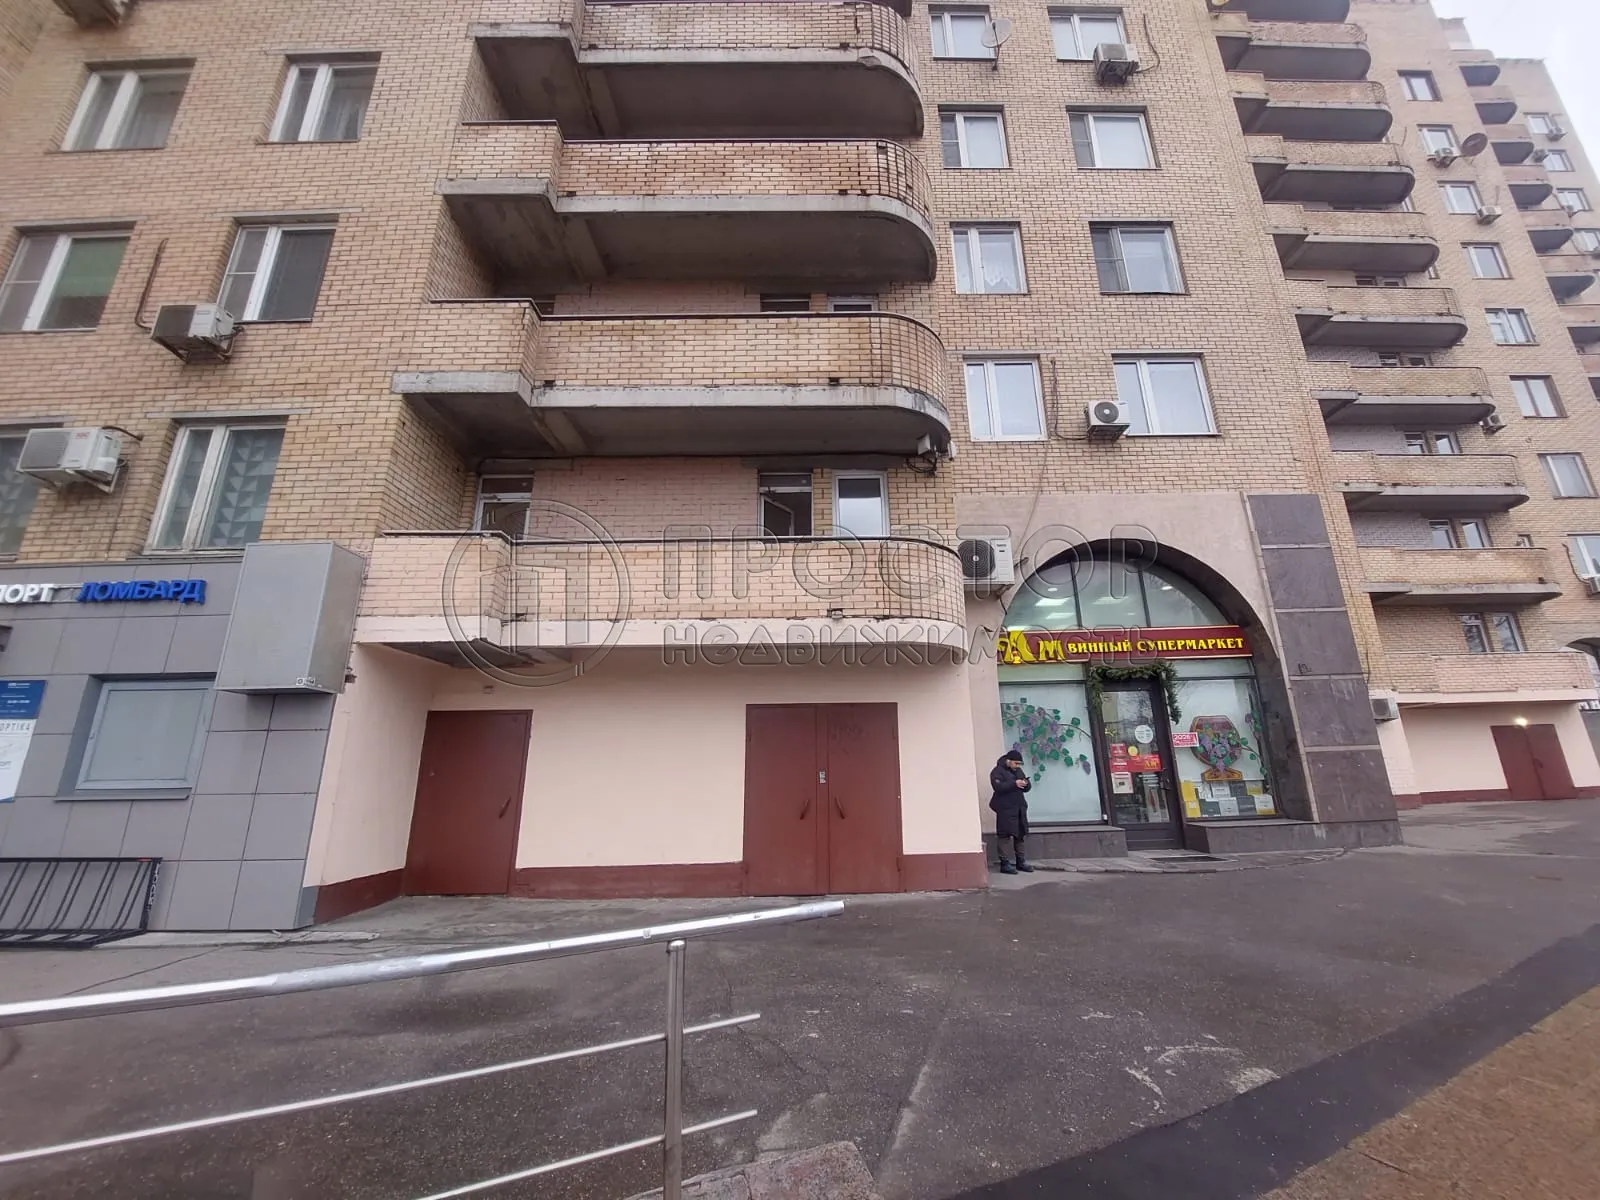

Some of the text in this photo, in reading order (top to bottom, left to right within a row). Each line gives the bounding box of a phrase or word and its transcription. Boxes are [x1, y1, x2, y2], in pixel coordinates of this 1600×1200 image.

[77, 579, 206, 606] ЛОМБАРД
[1068, 639, 1132, 653] ВИННЫЙ
[1137, 637, 1244, 652] СУПЕРМАРКЕТ
